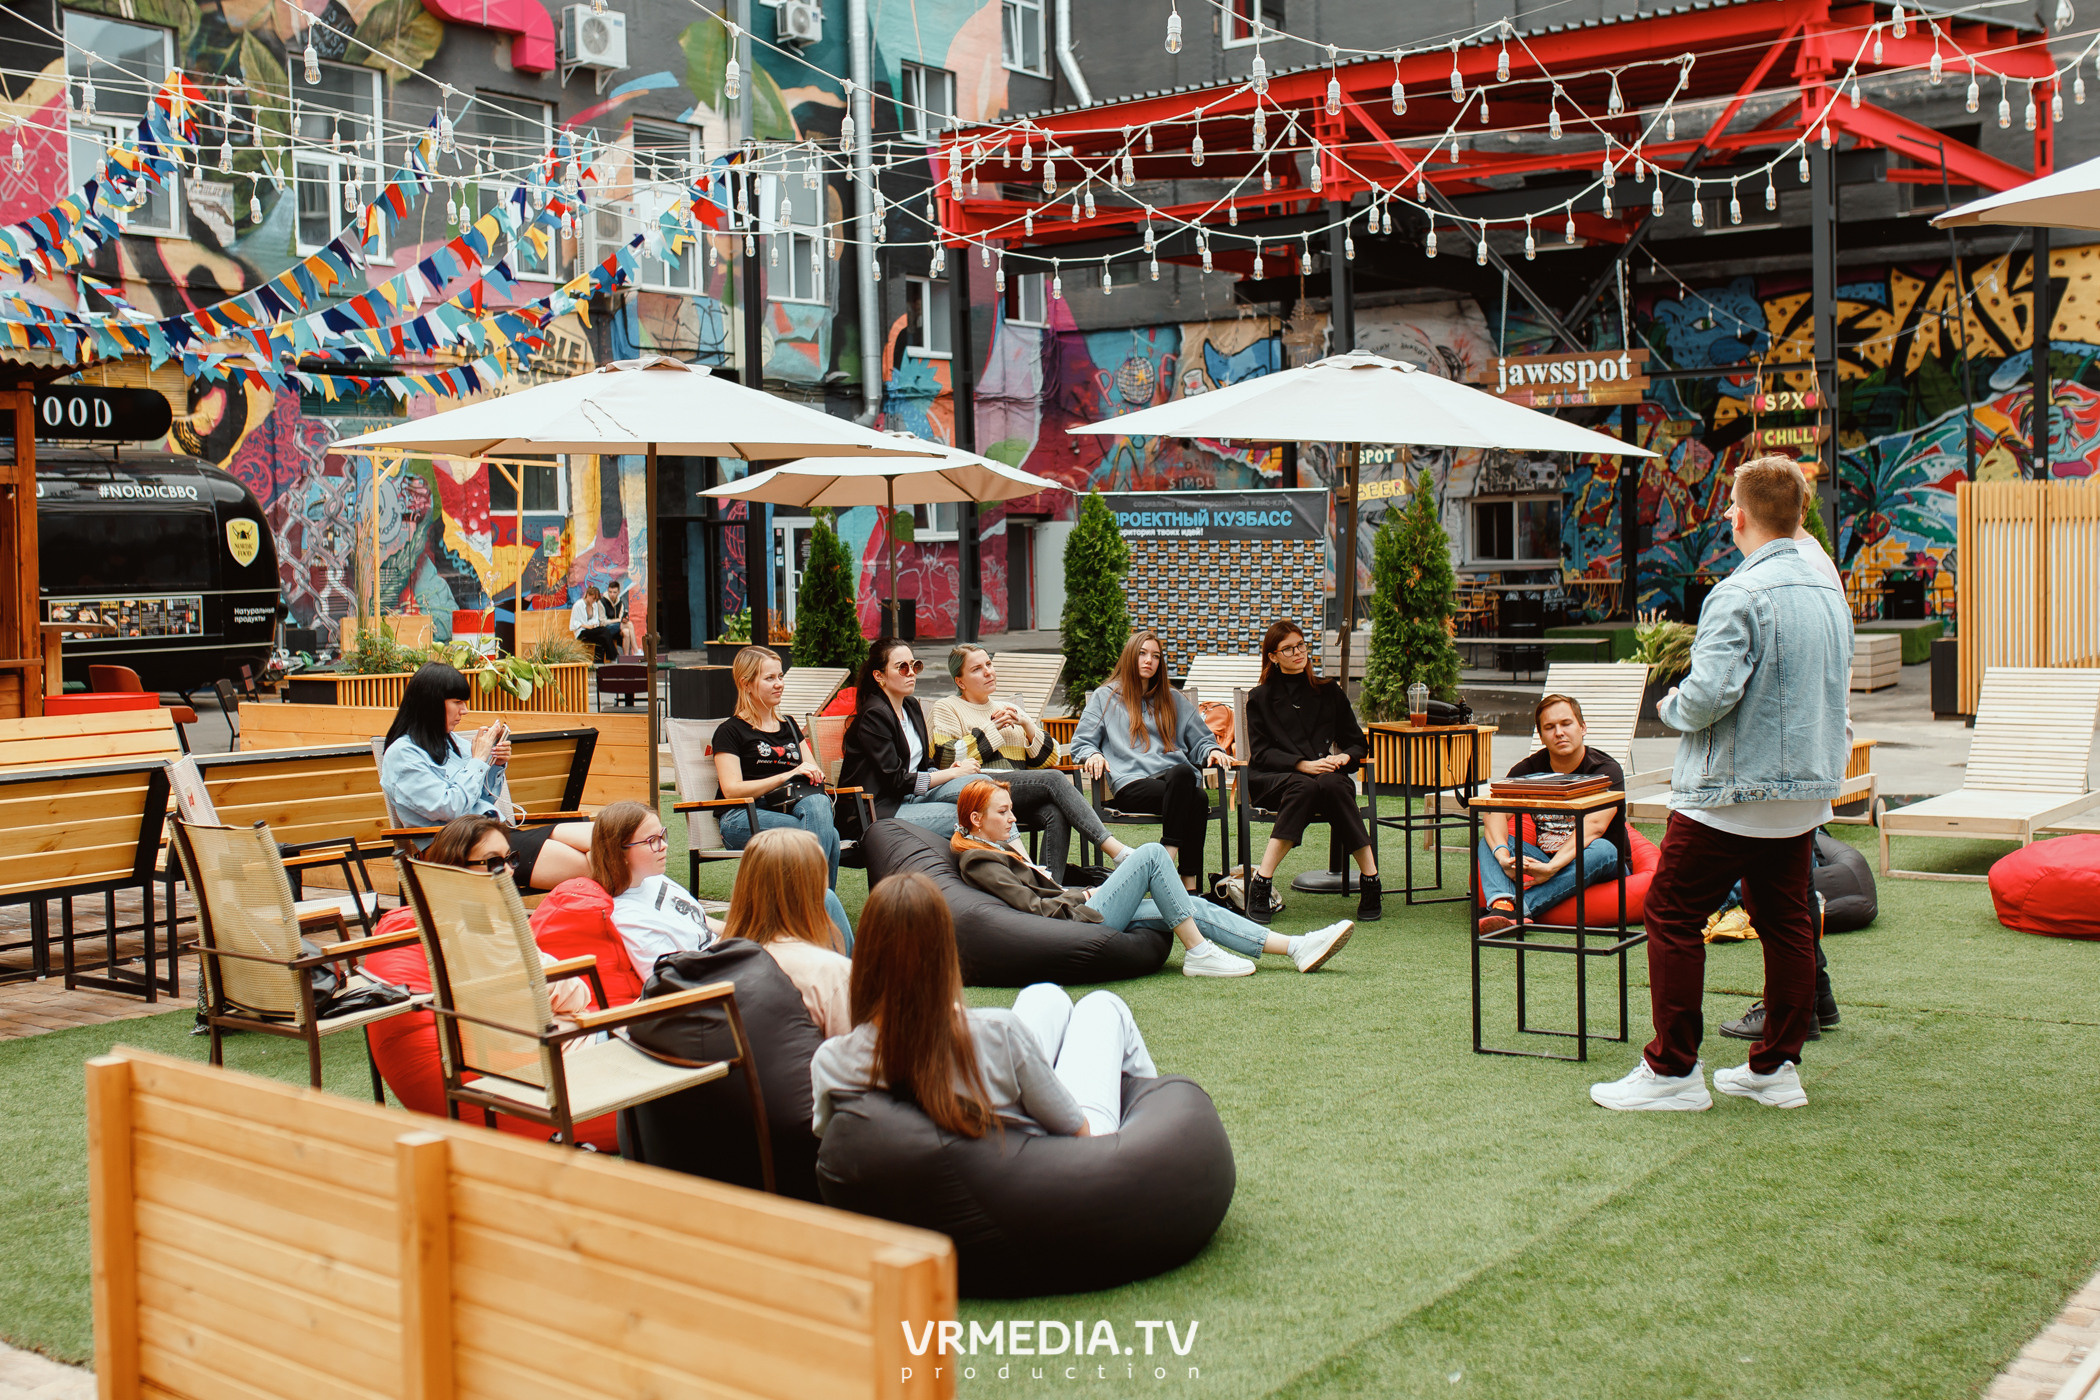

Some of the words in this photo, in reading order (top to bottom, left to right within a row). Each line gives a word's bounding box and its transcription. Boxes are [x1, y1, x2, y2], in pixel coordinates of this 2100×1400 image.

[1496, 351, 1632, 394] jawsspot
[1529, 389, 1562, 407] beer's
[1564, 386, 1597, 405] beach
[33, 396, 112, 427] OOD
[1764, 428, 1813, 446] CHILL
[1359, 448, 1395, 465] SPOT
[98, 485, 198, 500] #NORDICBBQ
[1358, 481, 1403, 498] BEER
[1647, 467, 1687, 505] LOVER
[1213, 511, 1293, 527] КУЗБАСС
[1119, 528, 1156, 538] ритория
[234, 607, 275, 616] Натуральные
[234, 615, 266, 624] продукты
